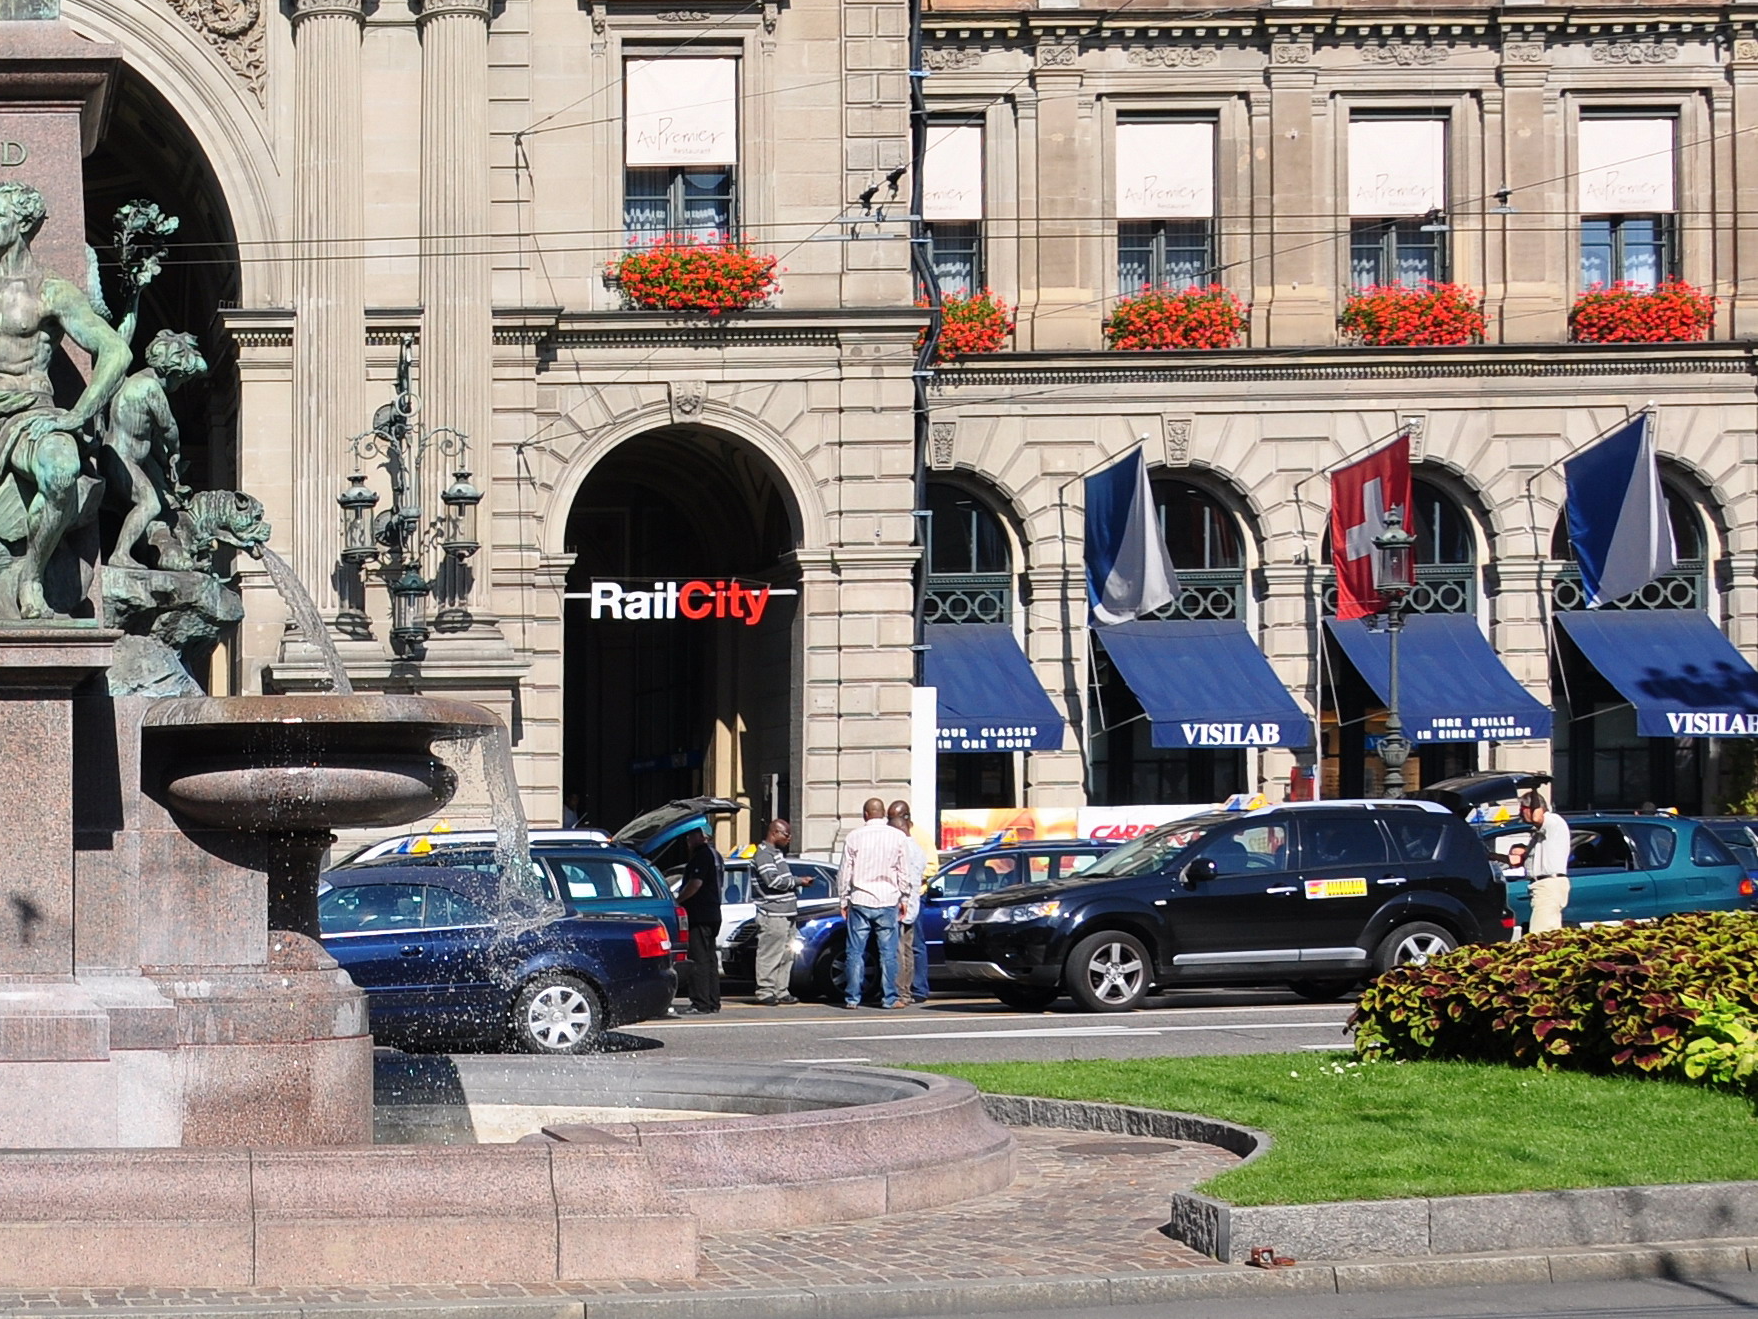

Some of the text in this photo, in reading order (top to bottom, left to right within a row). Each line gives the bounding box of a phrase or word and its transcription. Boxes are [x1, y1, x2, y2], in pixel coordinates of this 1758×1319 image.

[590, 580, 770, 625] RailCity
[1432, 716, 1515, 728] IHRE BRILLE
[981, 726, 1038, 737] GLASSES
[1181, 723, 1281, 745] VISILAB
[1417, 727, 1532, 740] IN EINER STUNDE
[937, 738, 1031, 749] IN ONE HOUR
